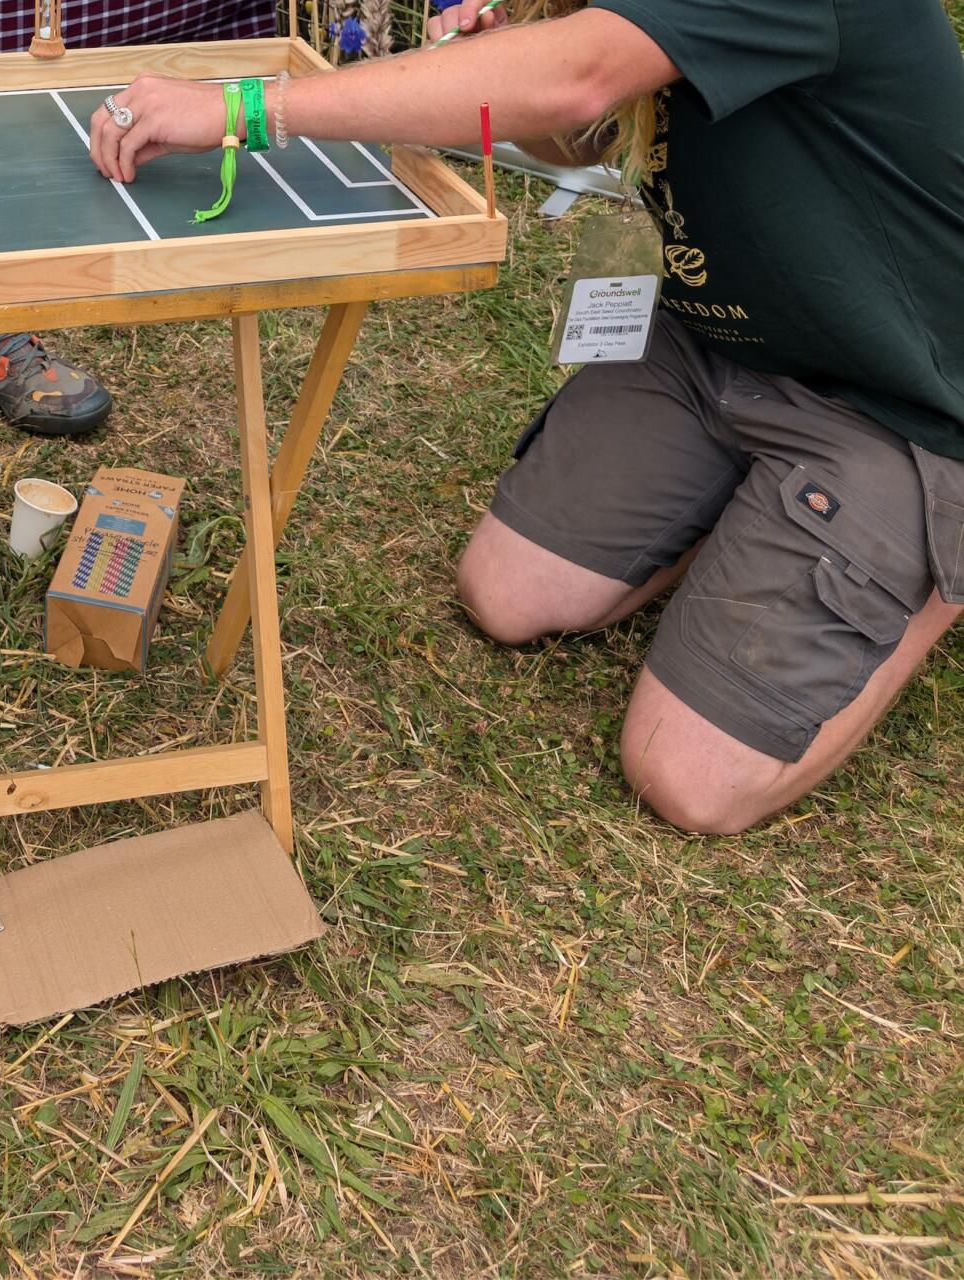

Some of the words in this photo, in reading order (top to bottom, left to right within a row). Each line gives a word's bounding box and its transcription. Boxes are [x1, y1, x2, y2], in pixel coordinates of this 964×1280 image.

[589, 288, 642, 299] Groundswell
[588, 301, 604, 309] Jack
[660, 295, 749, 319] REEDOM
